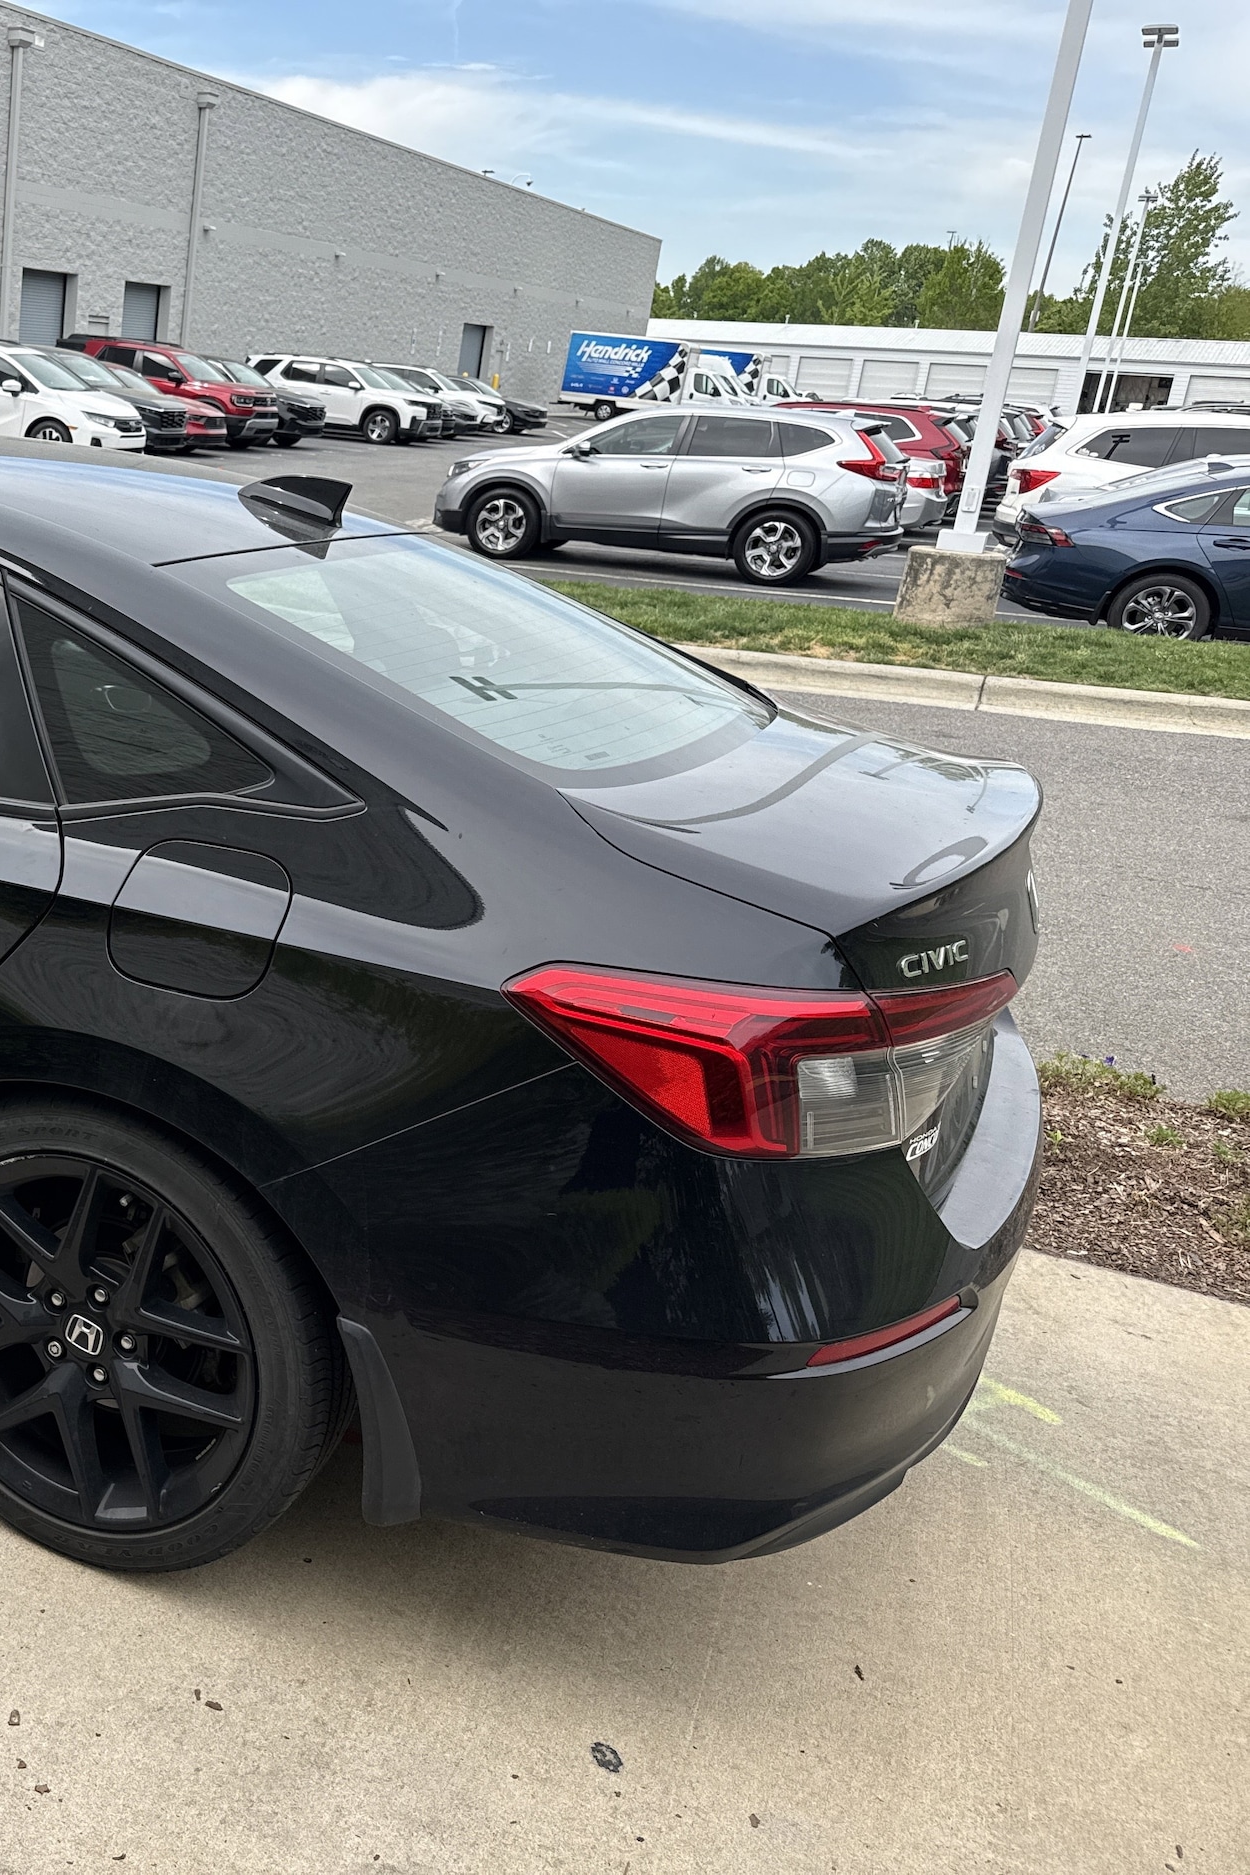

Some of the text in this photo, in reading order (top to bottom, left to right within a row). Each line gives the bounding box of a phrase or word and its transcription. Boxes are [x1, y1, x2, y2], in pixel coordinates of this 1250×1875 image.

[576, 340, 652, 362] Hendrick
[900, 940, 969, 977] CIVIC
[17, 1126, 98, 1141] SPORT
